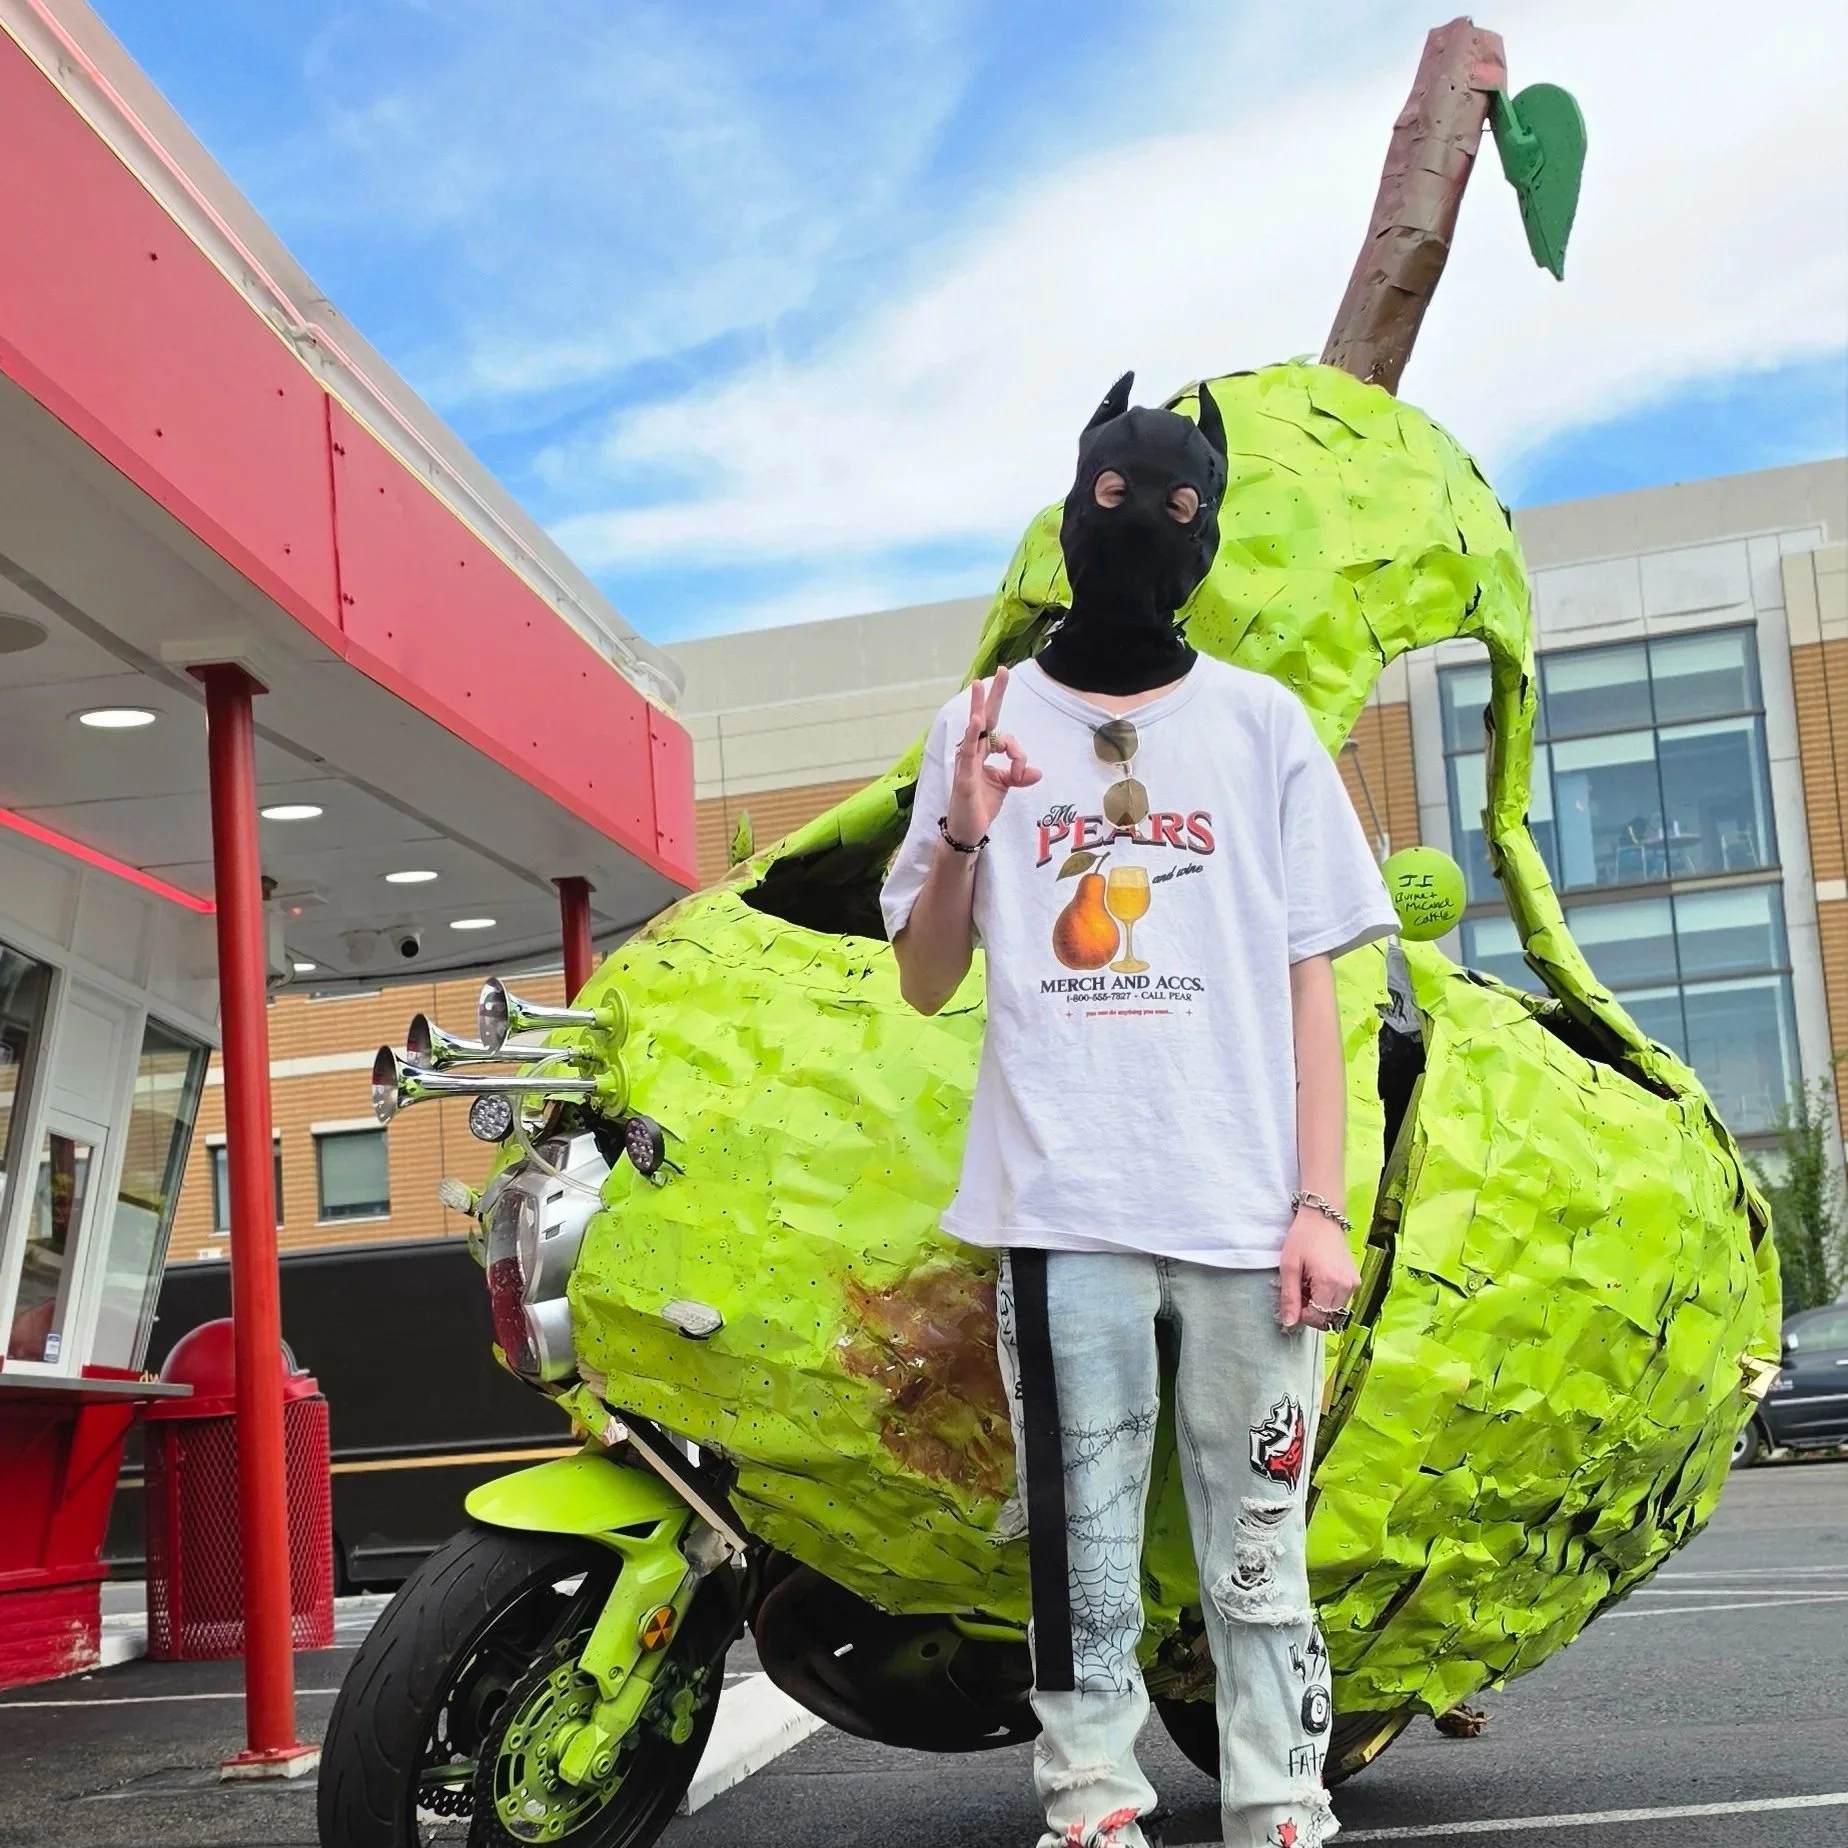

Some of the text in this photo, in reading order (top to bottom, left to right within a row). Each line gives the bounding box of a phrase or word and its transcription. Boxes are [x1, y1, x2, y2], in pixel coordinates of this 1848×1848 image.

[1042, 804, 1076, 827] My
[1036, 811, 1215, 868] PEARS
[1152, 863, 1203, 884] and wine
[1041, 976, 1205, 993] MERCH AND ACCS.
[1141, 992, 1166, 1000] CALL
[1169, 992, 1192, 1001] PEAR
